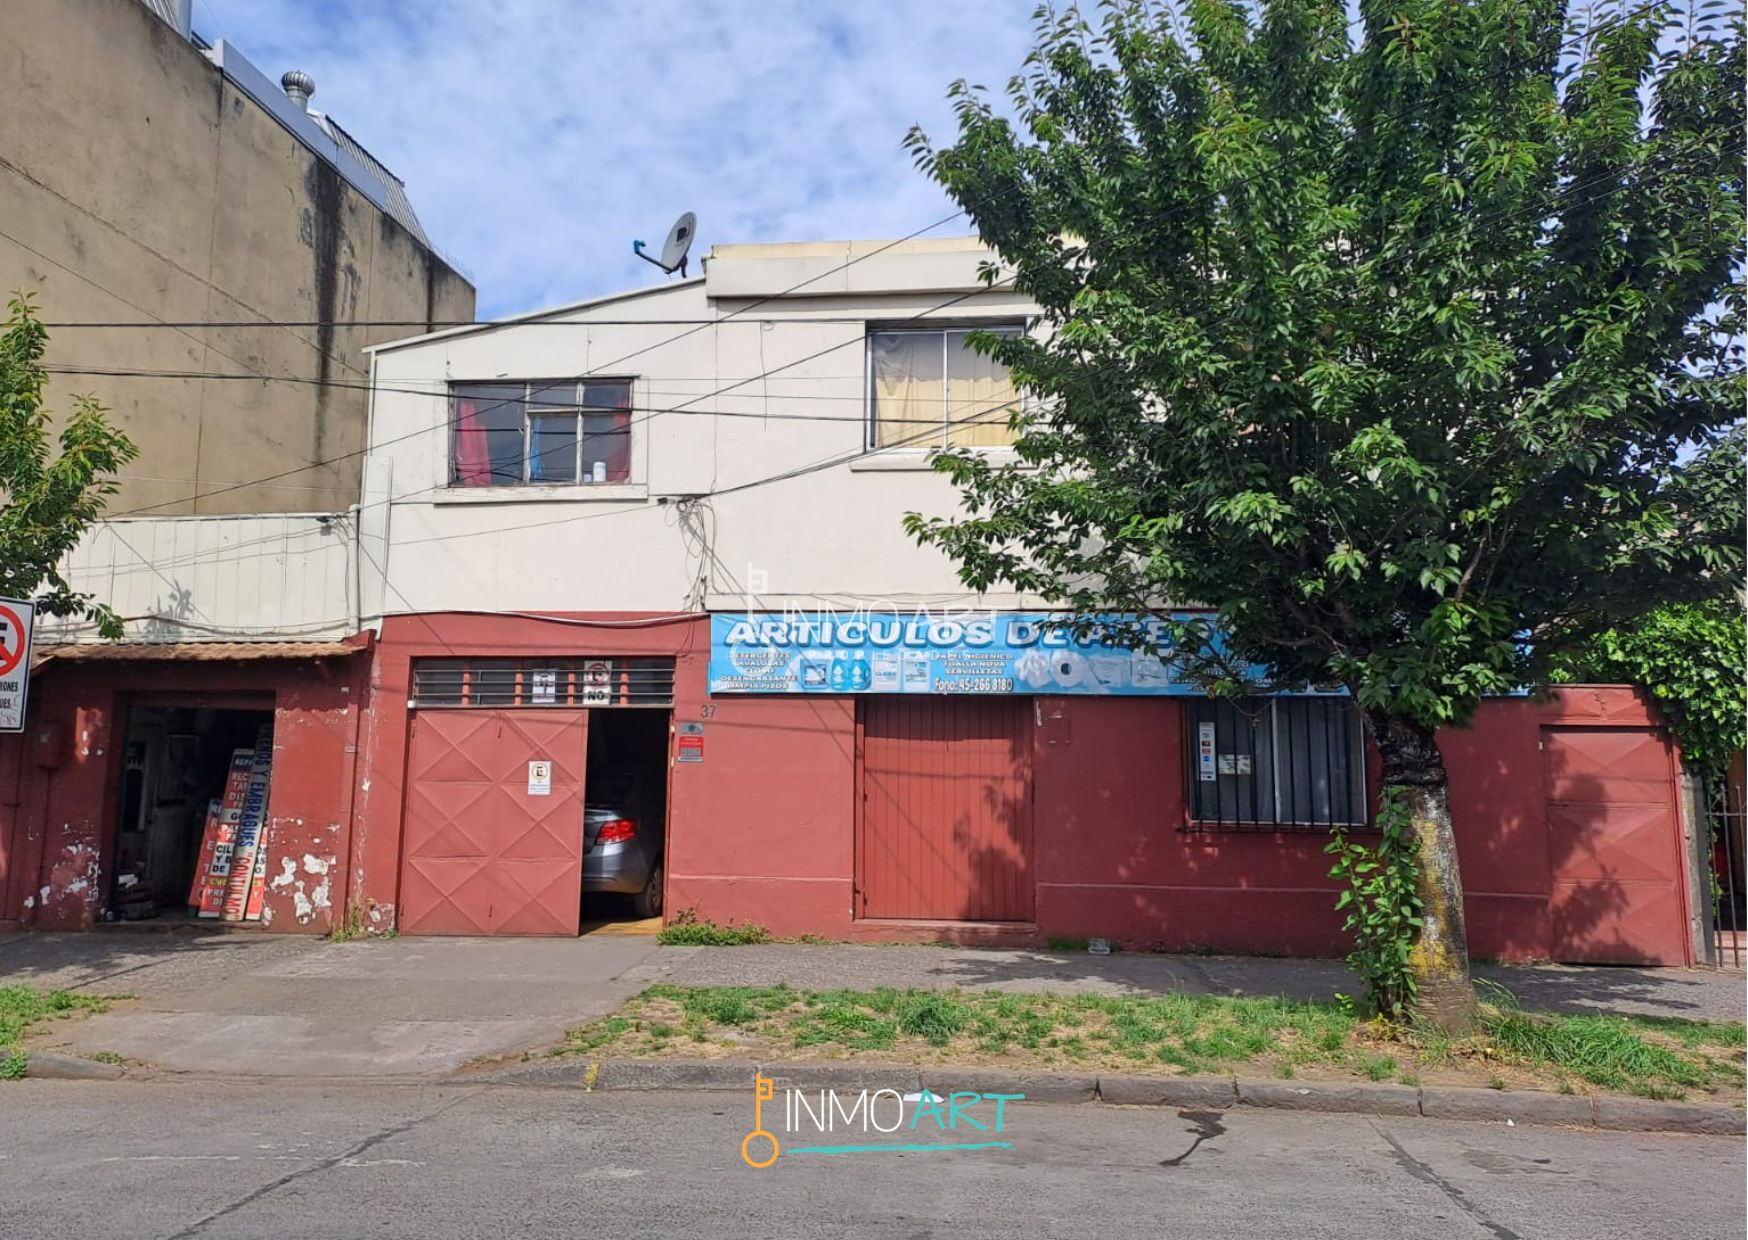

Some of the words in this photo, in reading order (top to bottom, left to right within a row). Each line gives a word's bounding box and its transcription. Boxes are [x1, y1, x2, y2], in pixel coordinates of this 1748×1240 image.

[723, 620, 993, 648] ARTICULOS
[1006, 621, 1069, 648] DE
[935, 677, 958, 692] Fono:
[959, 677, 991, 692] 45-266
[992, 677, 1013, 692] 8180
[587, 690, 605, 700] NO
[700, 704, 717, 718] 37
[238, 782, 266, 848] EMBRAGUES
